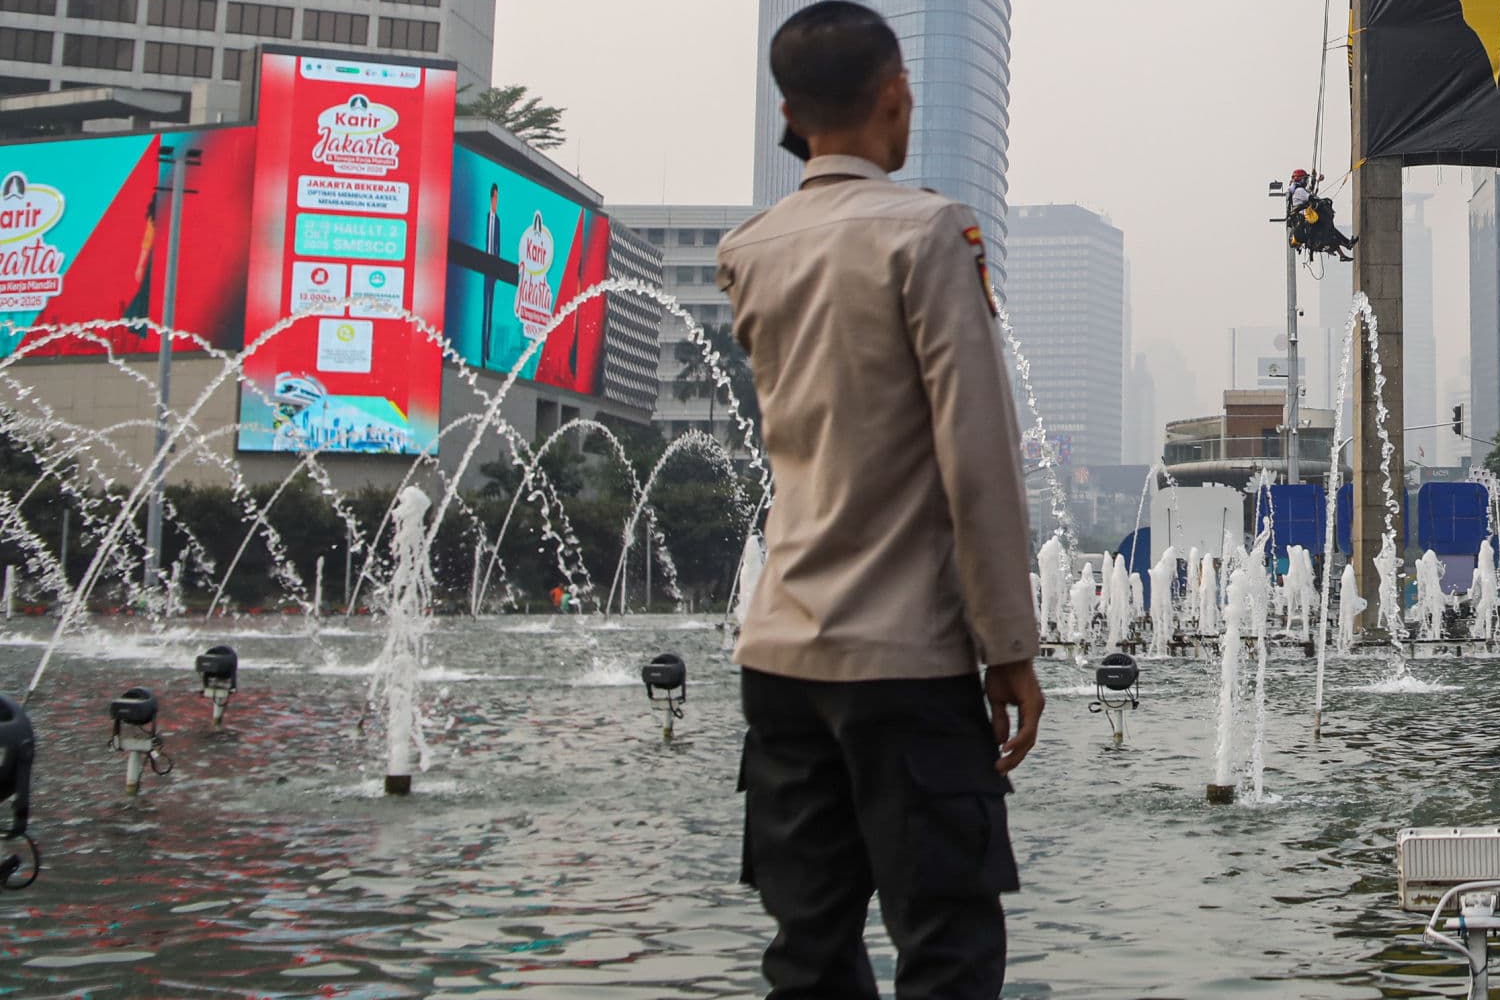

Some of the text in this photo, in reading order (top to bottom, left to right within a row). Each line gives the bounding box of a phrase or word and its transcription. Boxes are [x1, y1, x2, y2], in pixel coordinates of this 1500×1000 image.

[335, 112, 381, 128] Karir
[314, 127, 394, 159] Jakarta
[307, 180, 352, 190] JAKARTA
[0, 202, 41, 229] arir
[334, 223, 367, 236] HALL
[0, 238, 57, 277] arta
[333, 239, 397, 255] SMESCO
[526, 237, 547, 265] Karir
